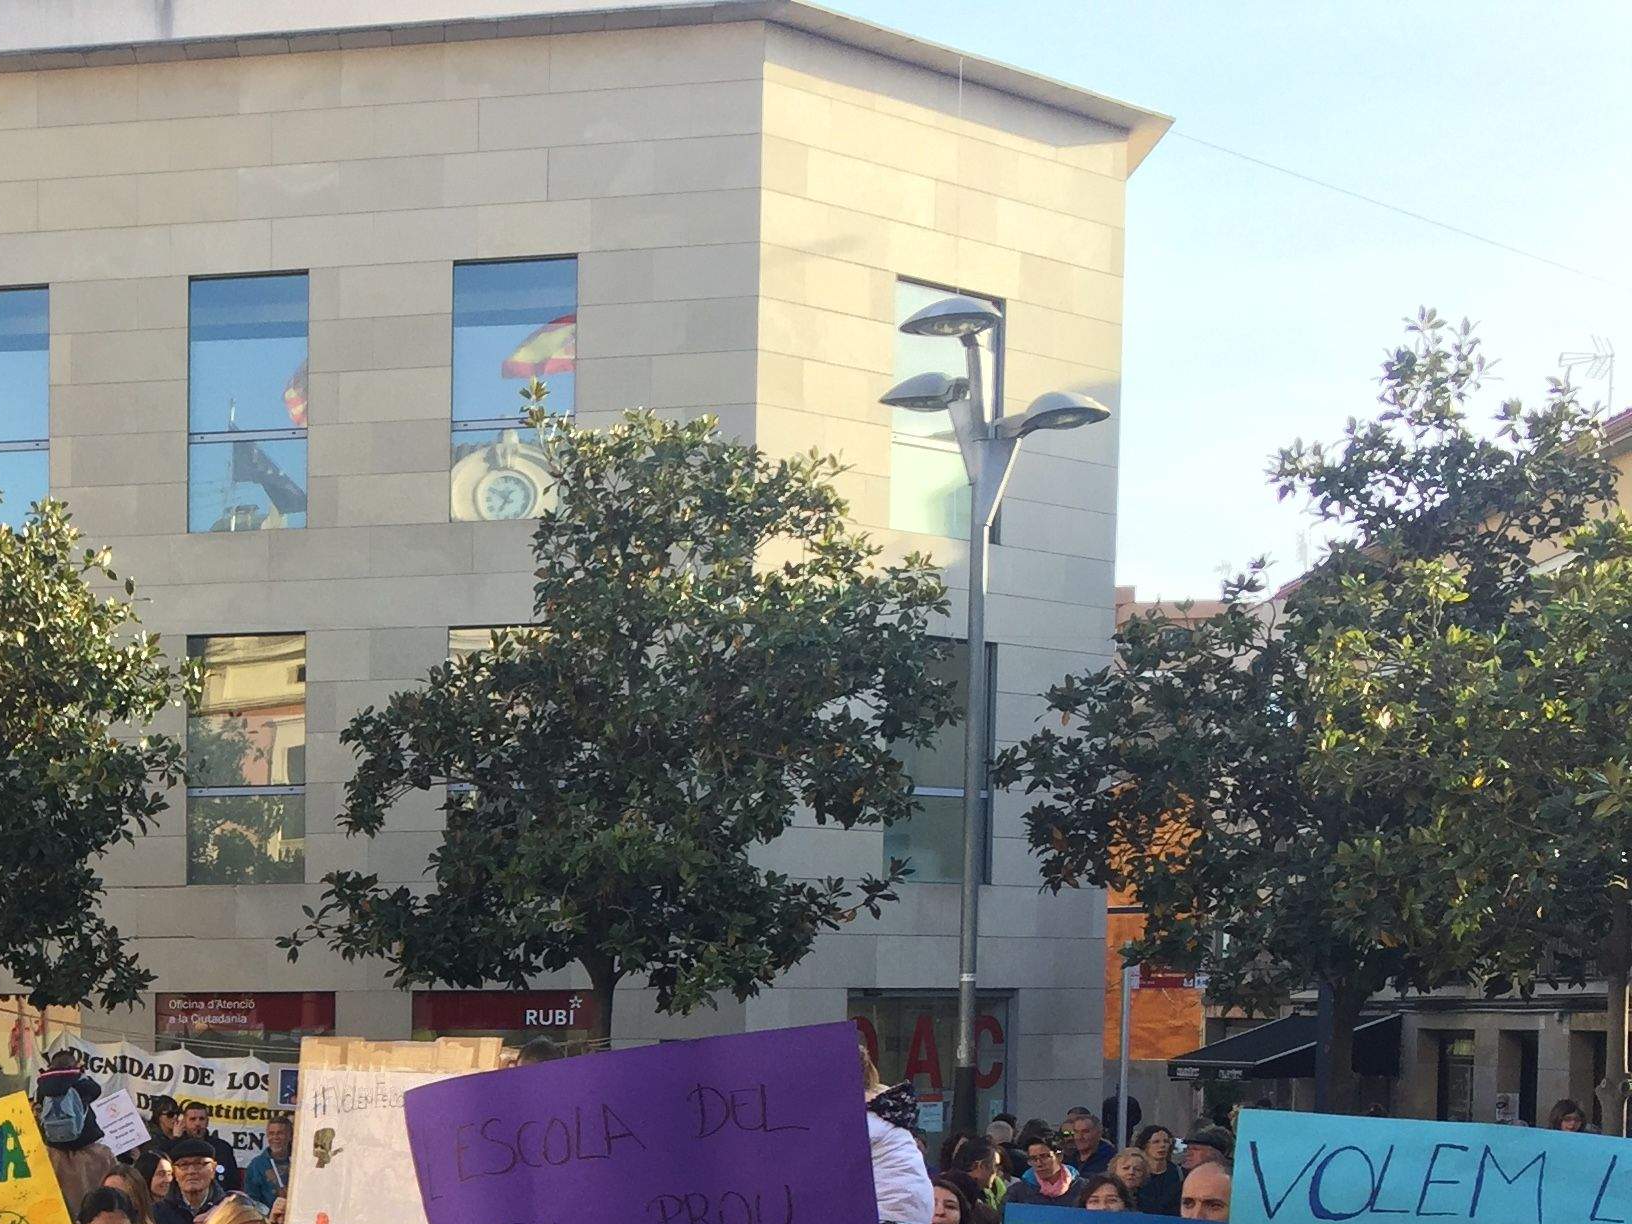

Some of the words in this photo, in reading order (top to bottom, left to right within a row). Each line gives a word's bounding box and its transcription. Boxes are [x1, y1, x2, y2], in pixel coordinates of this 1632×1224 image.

[168, 999, 205, 1010] Oficina
[207, 998, 256, 1010] d'Atenció
[168, 1015, 177, 1024] a
[178, 1013, 189, 1024] la
[190, 1013, 248, 1024] Ciutadania
[182, 1064, 215, 1088] DE
[686, 1083, 810, 1140] DEL
[232, 1131, 266, 1151] EN
